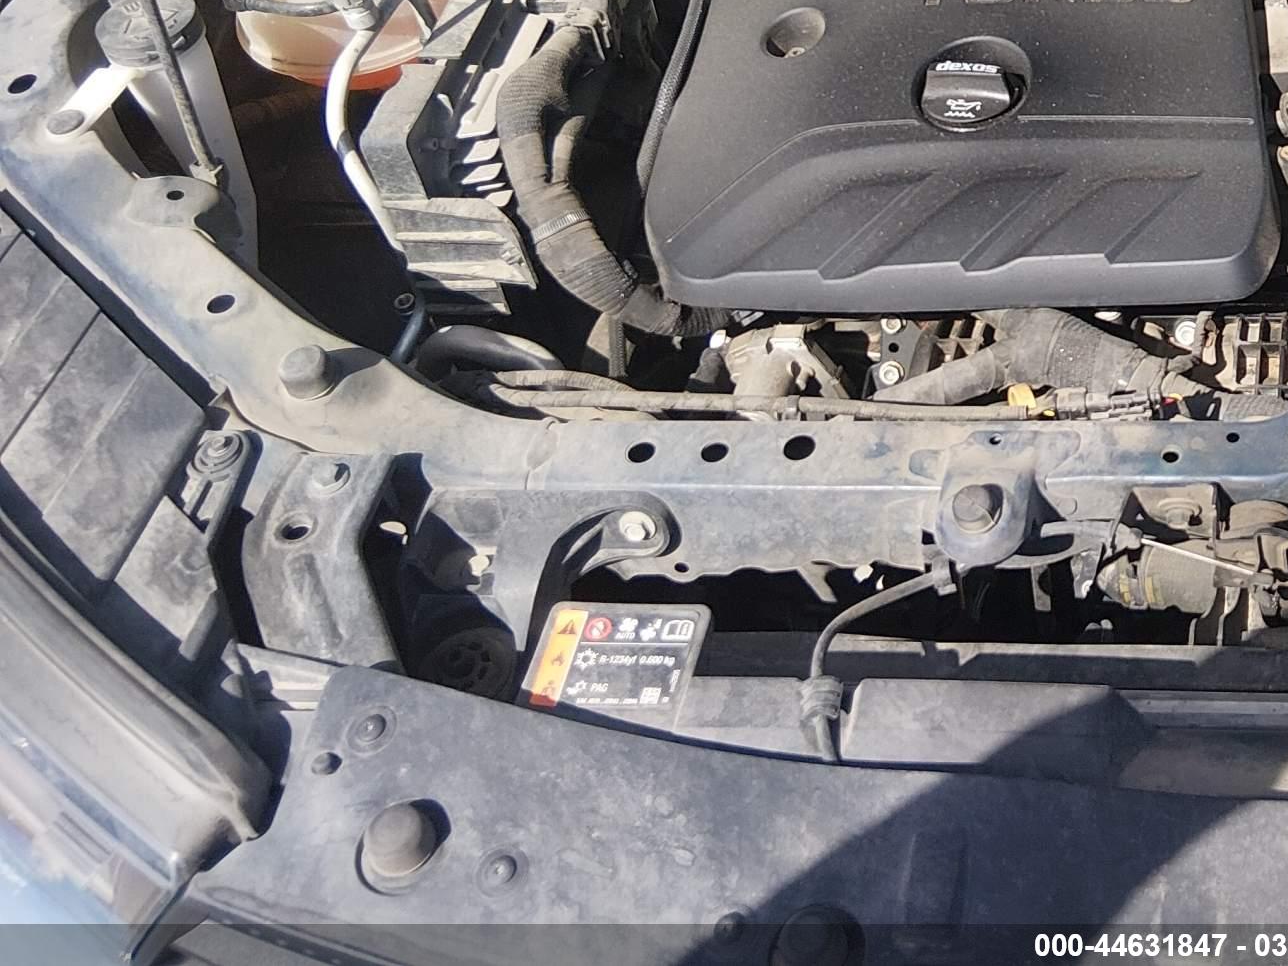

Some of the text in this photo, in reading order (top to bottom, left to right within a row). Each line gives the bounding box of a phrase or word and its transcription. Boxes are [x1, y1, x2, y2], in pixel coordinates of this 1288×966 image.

[935, 60, 1001, 74] dexos
[614, 631, 636, 640] AUTO
[599, 655, 638, 666] R-1234yf
[590, 683, 609, 693] PAG
